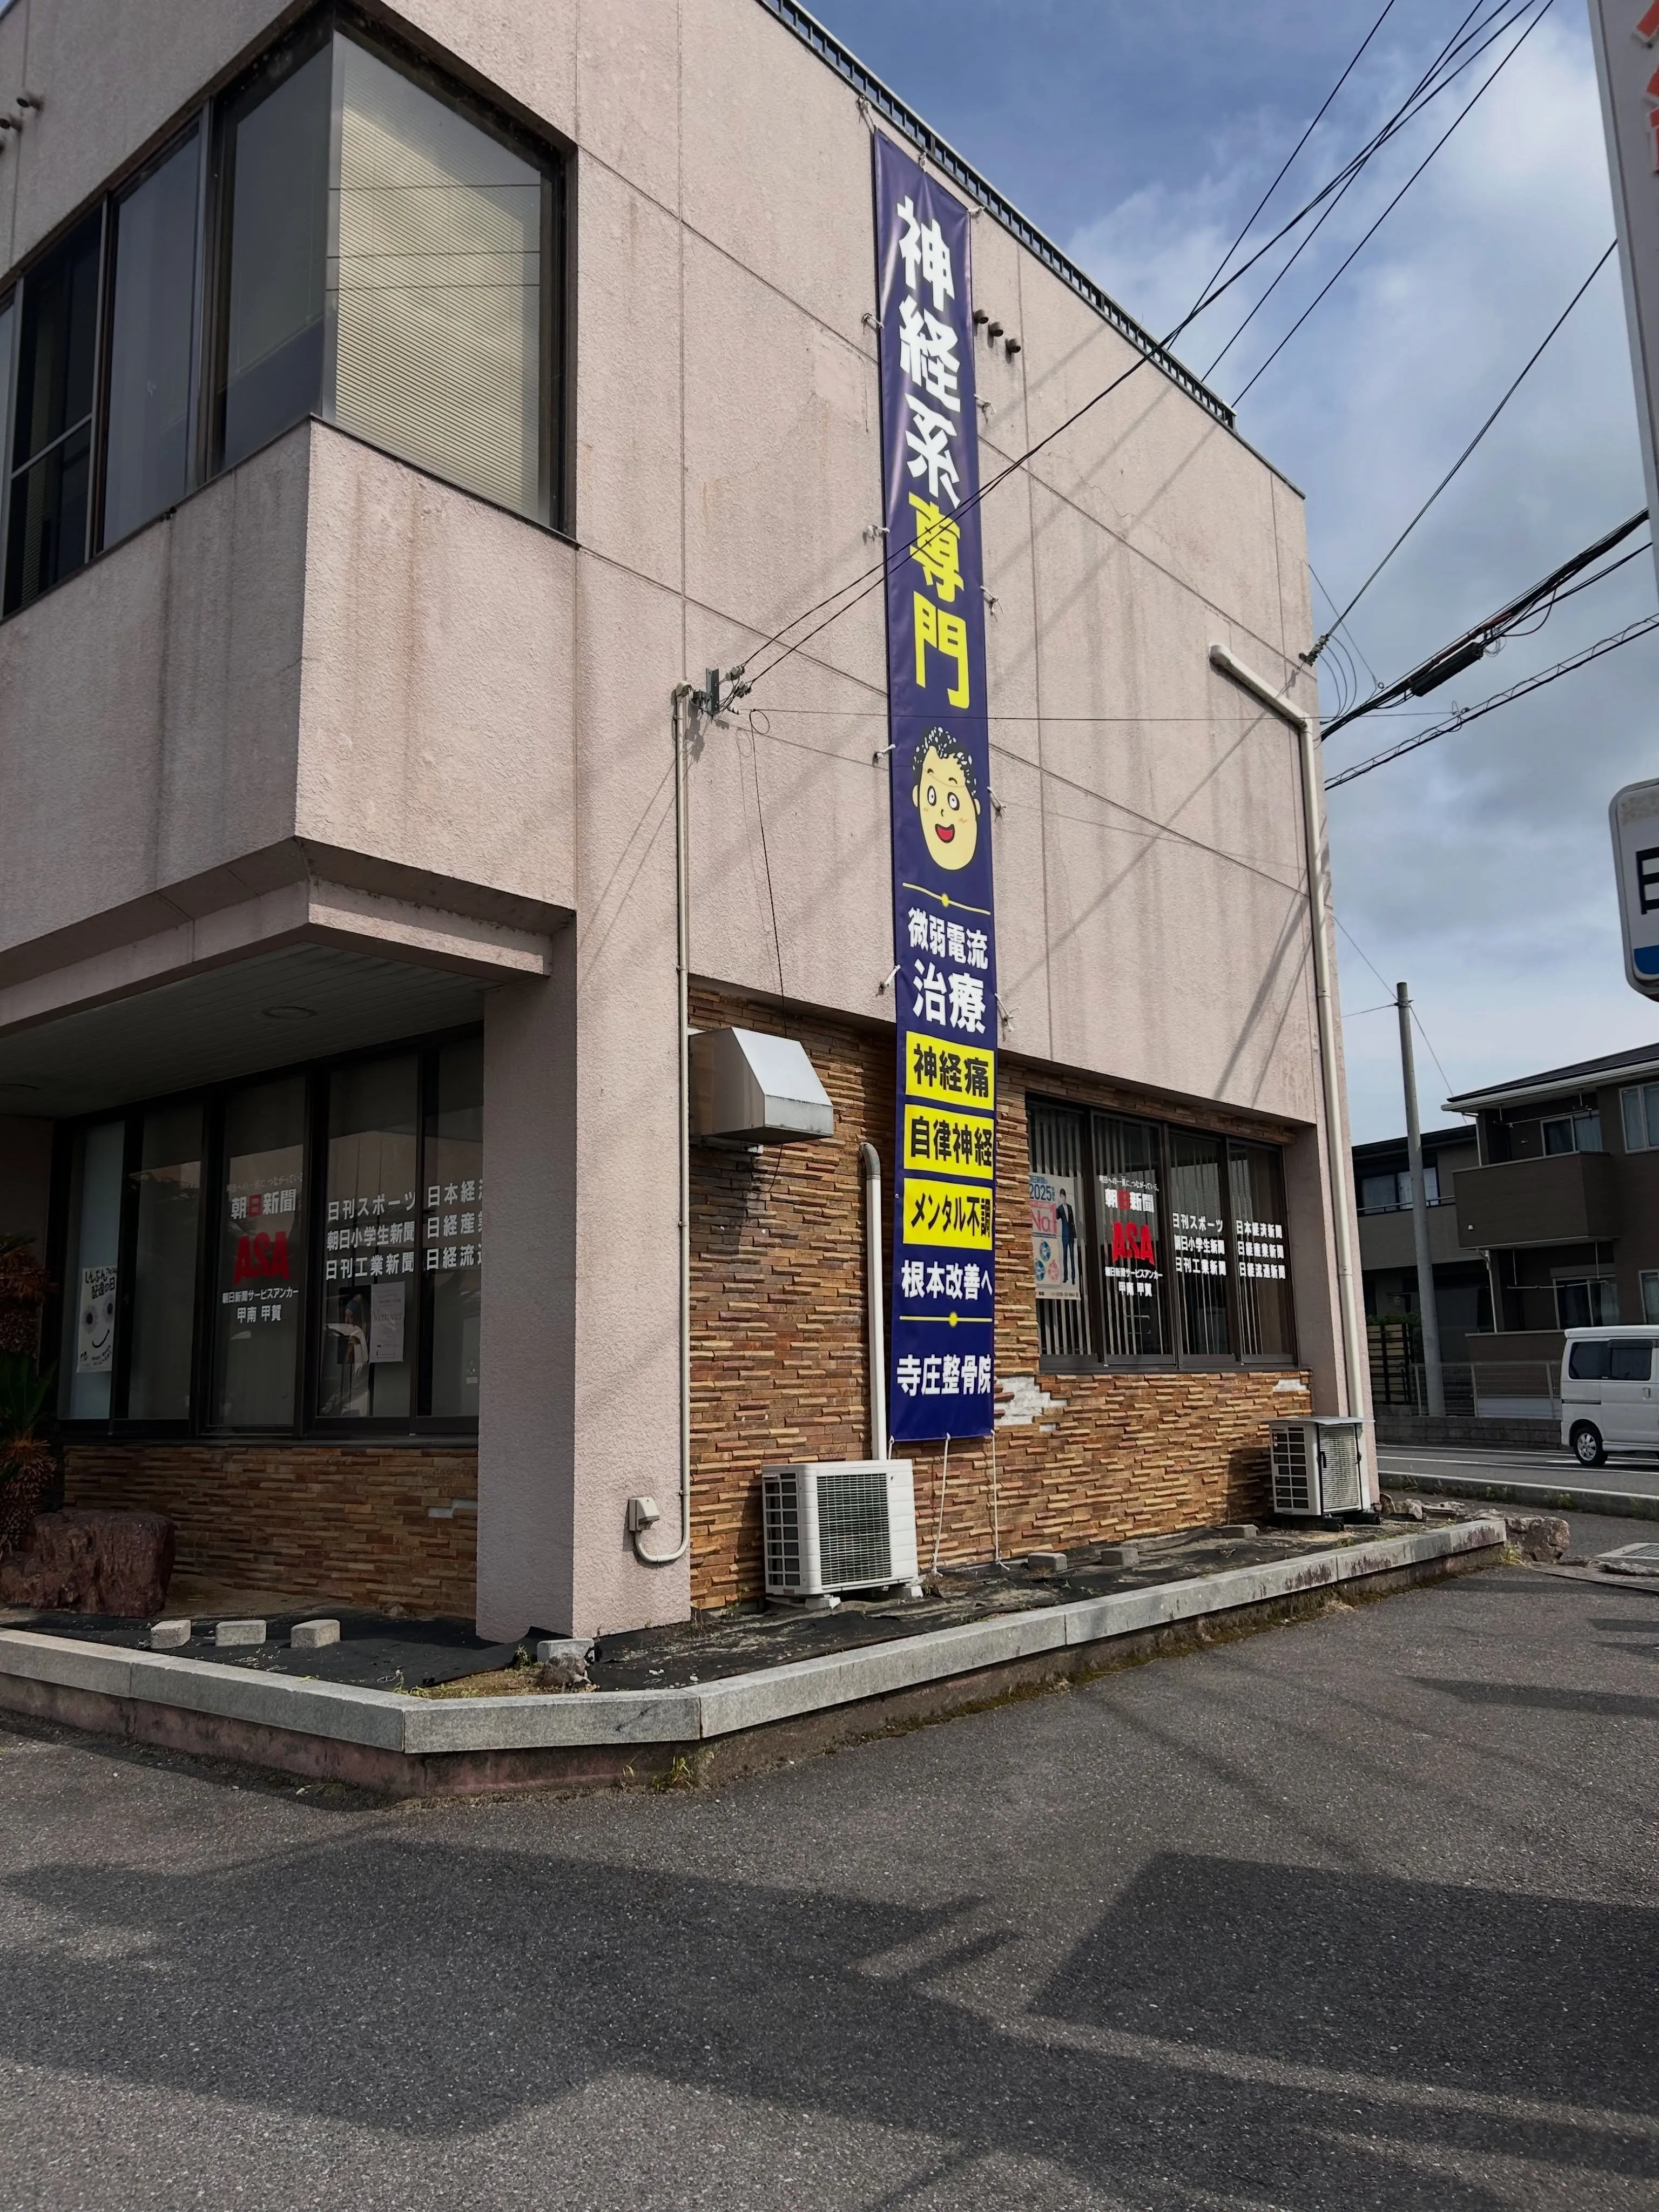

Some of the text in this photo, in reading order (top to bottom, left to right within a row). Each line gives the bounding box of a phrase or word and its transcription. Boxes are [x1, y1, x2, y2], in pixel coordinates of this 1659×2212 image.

[895, 195, 970, 710] 神経系専門
[907, 906, 989, 970] 微弱電流
[912, 958, 987, 1034] 治療
[913, 1043, 989, 1098] 神経痛
[911, 1115, 993, 1167] 自律神経
[231, 1189, 296, 1220] 朝日新聞
[327, 1191, 416, 1221] 日刊スポーツ
[428, 1179, 483, 1208] 日本経
[1030, 1183, 1052, 1202] 2025
[1104, 1188, 1155, 1213] 朝日新聞
[427, 1210, 483, 1239] 日経産
[911, 1192, 991, 1238] メンタル不調
[1172, 1212, 1223, 1233] 日刊スポーツ
[1236, 1219, 1283, 1239] 日本経済新聞
[326, 1220, 415, 1251] 朝日小学生新聞
[1112, 1220, 1156, 1266] ASA
[1174, 1234, 1225, 1255] 朝日小学生新聞
[232, 1231, 289, 1285] ASA
[326, 1251, 415, 1281] 日刊工業新聞
[426, 1243, 482, 1271] 日経流
[1175, 1256, 1226, 1276] 日刊工業新聞
[901, 1259, 993, 1300] 根本改善へ
[1104, 1266, 1163, 1280] 朝日新聞サービスアンカー
[222, 1286, 299, 1304] 朝日新聞サービスアンカー
[237, 1304, 281, 1324] 甲南 甲賀
[896, 1353, 992, 1397] 寺庄整骨院
